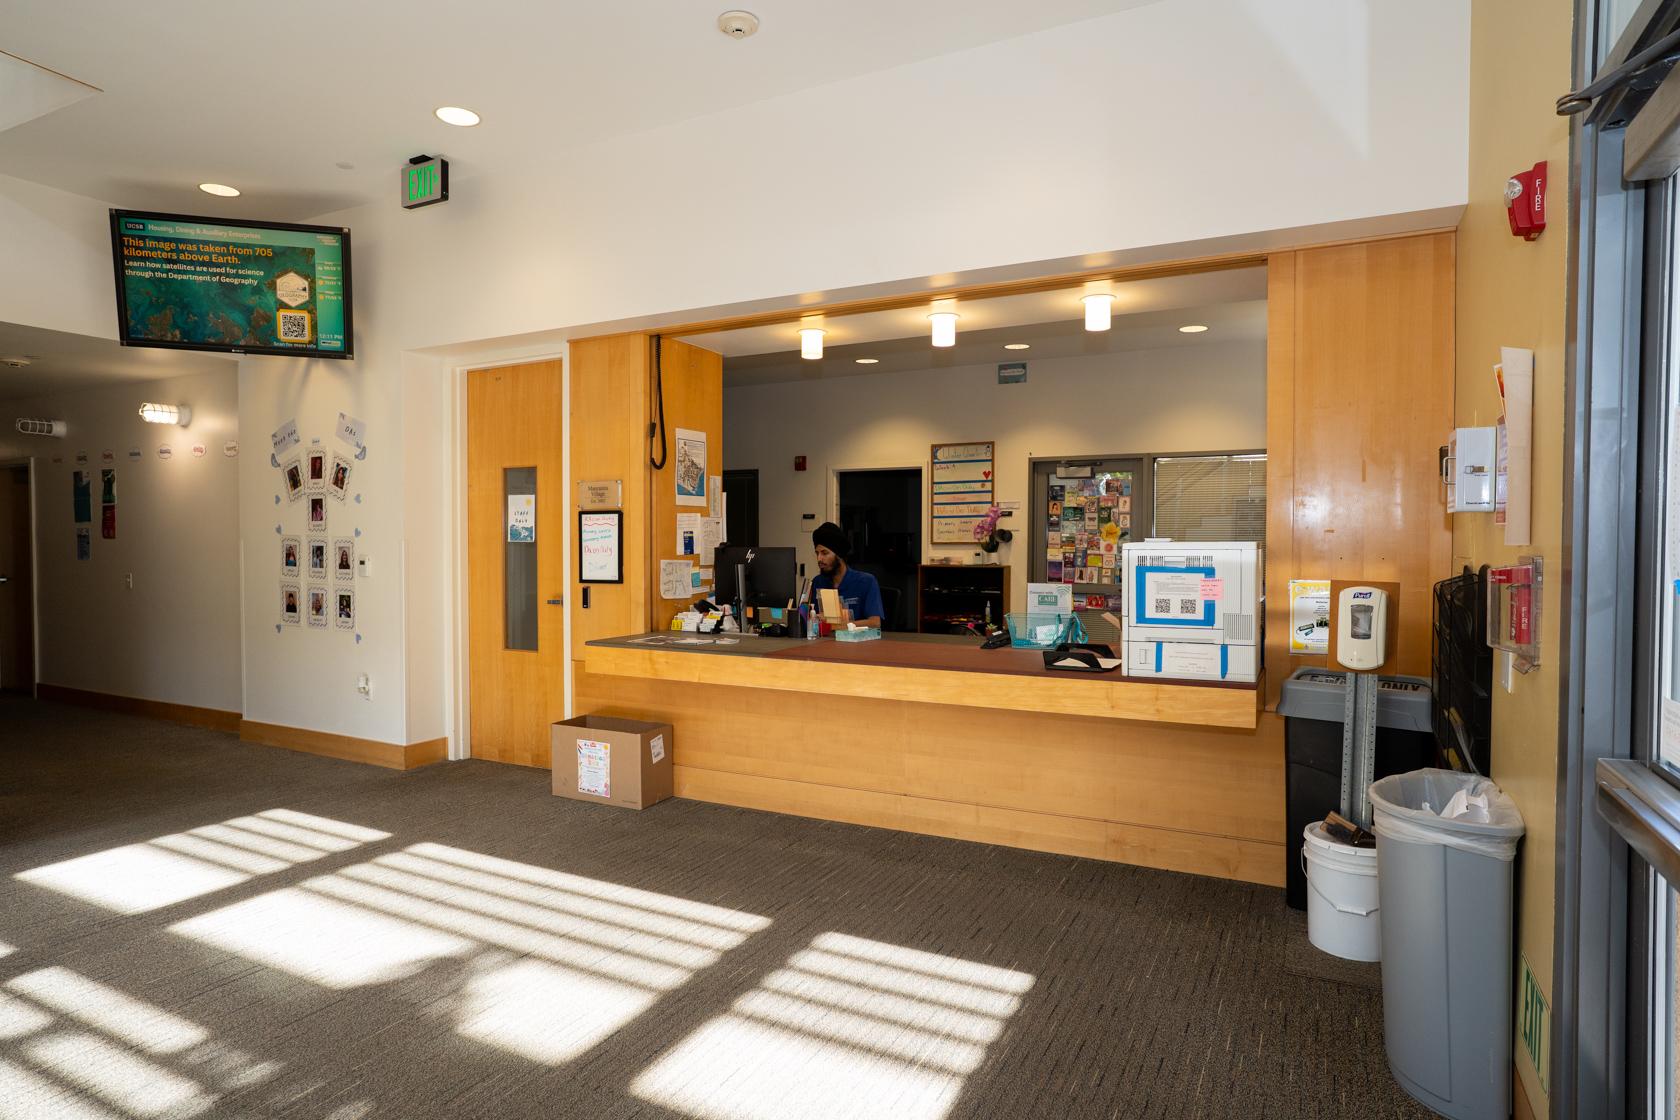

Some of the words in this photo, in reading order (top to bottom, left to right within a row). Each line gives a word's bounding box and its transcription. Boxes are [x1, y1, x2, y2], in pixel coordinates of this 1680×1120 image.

[408, 164, 439, 201] EXIT
[123, 237, 144, 247] This
[146, 239, 176, 250] image
[178, 243, 197, 251] was
[200, 244, 227, 253] taken
[230, 246, 252, 255] from
[255, 248, 272, 257] 705
[124, 247, 177, 259] kilometers
[179, 252, 210, 262] above
[212, 254, 240, 264] Earth.
[163, 263, 194, 271] satellites
[125, 270, 154, 278] through
[169, 273, 210, 281] Department
[221, 276, 258, 286] Geography
[746, 549, 755, 563] hp
[1524, 969, 1543, 1074] EXIT
